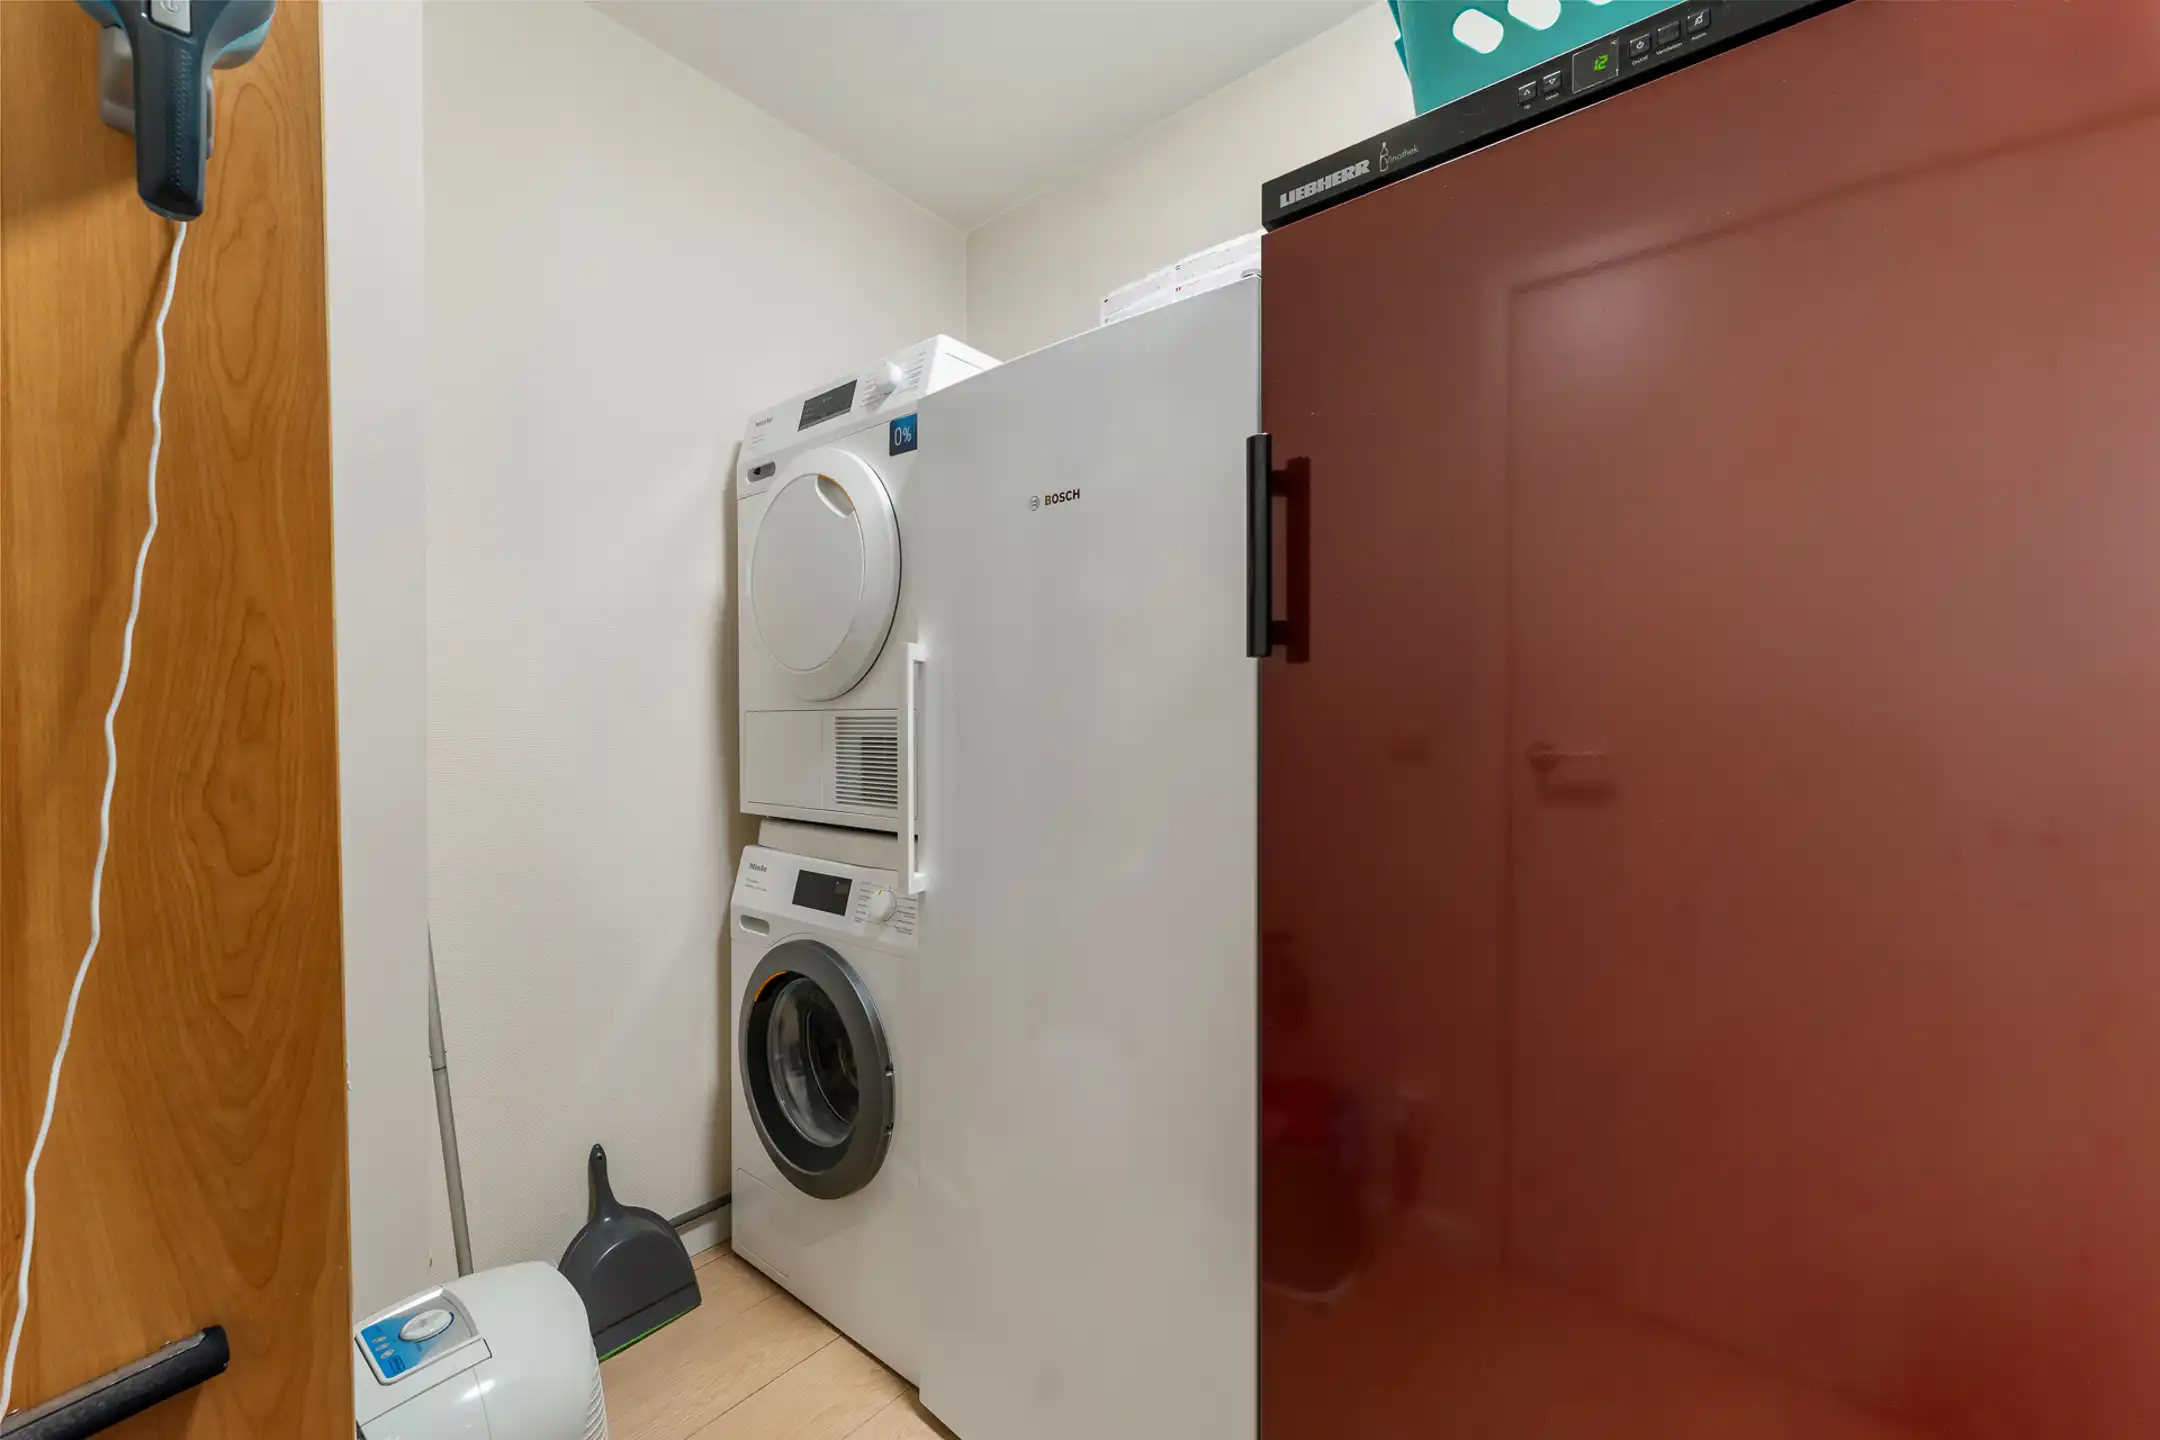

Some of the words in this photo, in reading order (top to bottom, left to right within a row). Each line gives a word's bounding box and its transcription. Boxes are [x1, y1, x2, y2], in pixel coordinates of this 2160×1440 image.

[1594, 55, 1609, 71] 12
[1280, 159, 1370, 208] LIEBHERR
[894, 427, 912, 446] 0%
[1044, 488, 1080, 505] BOSCH
